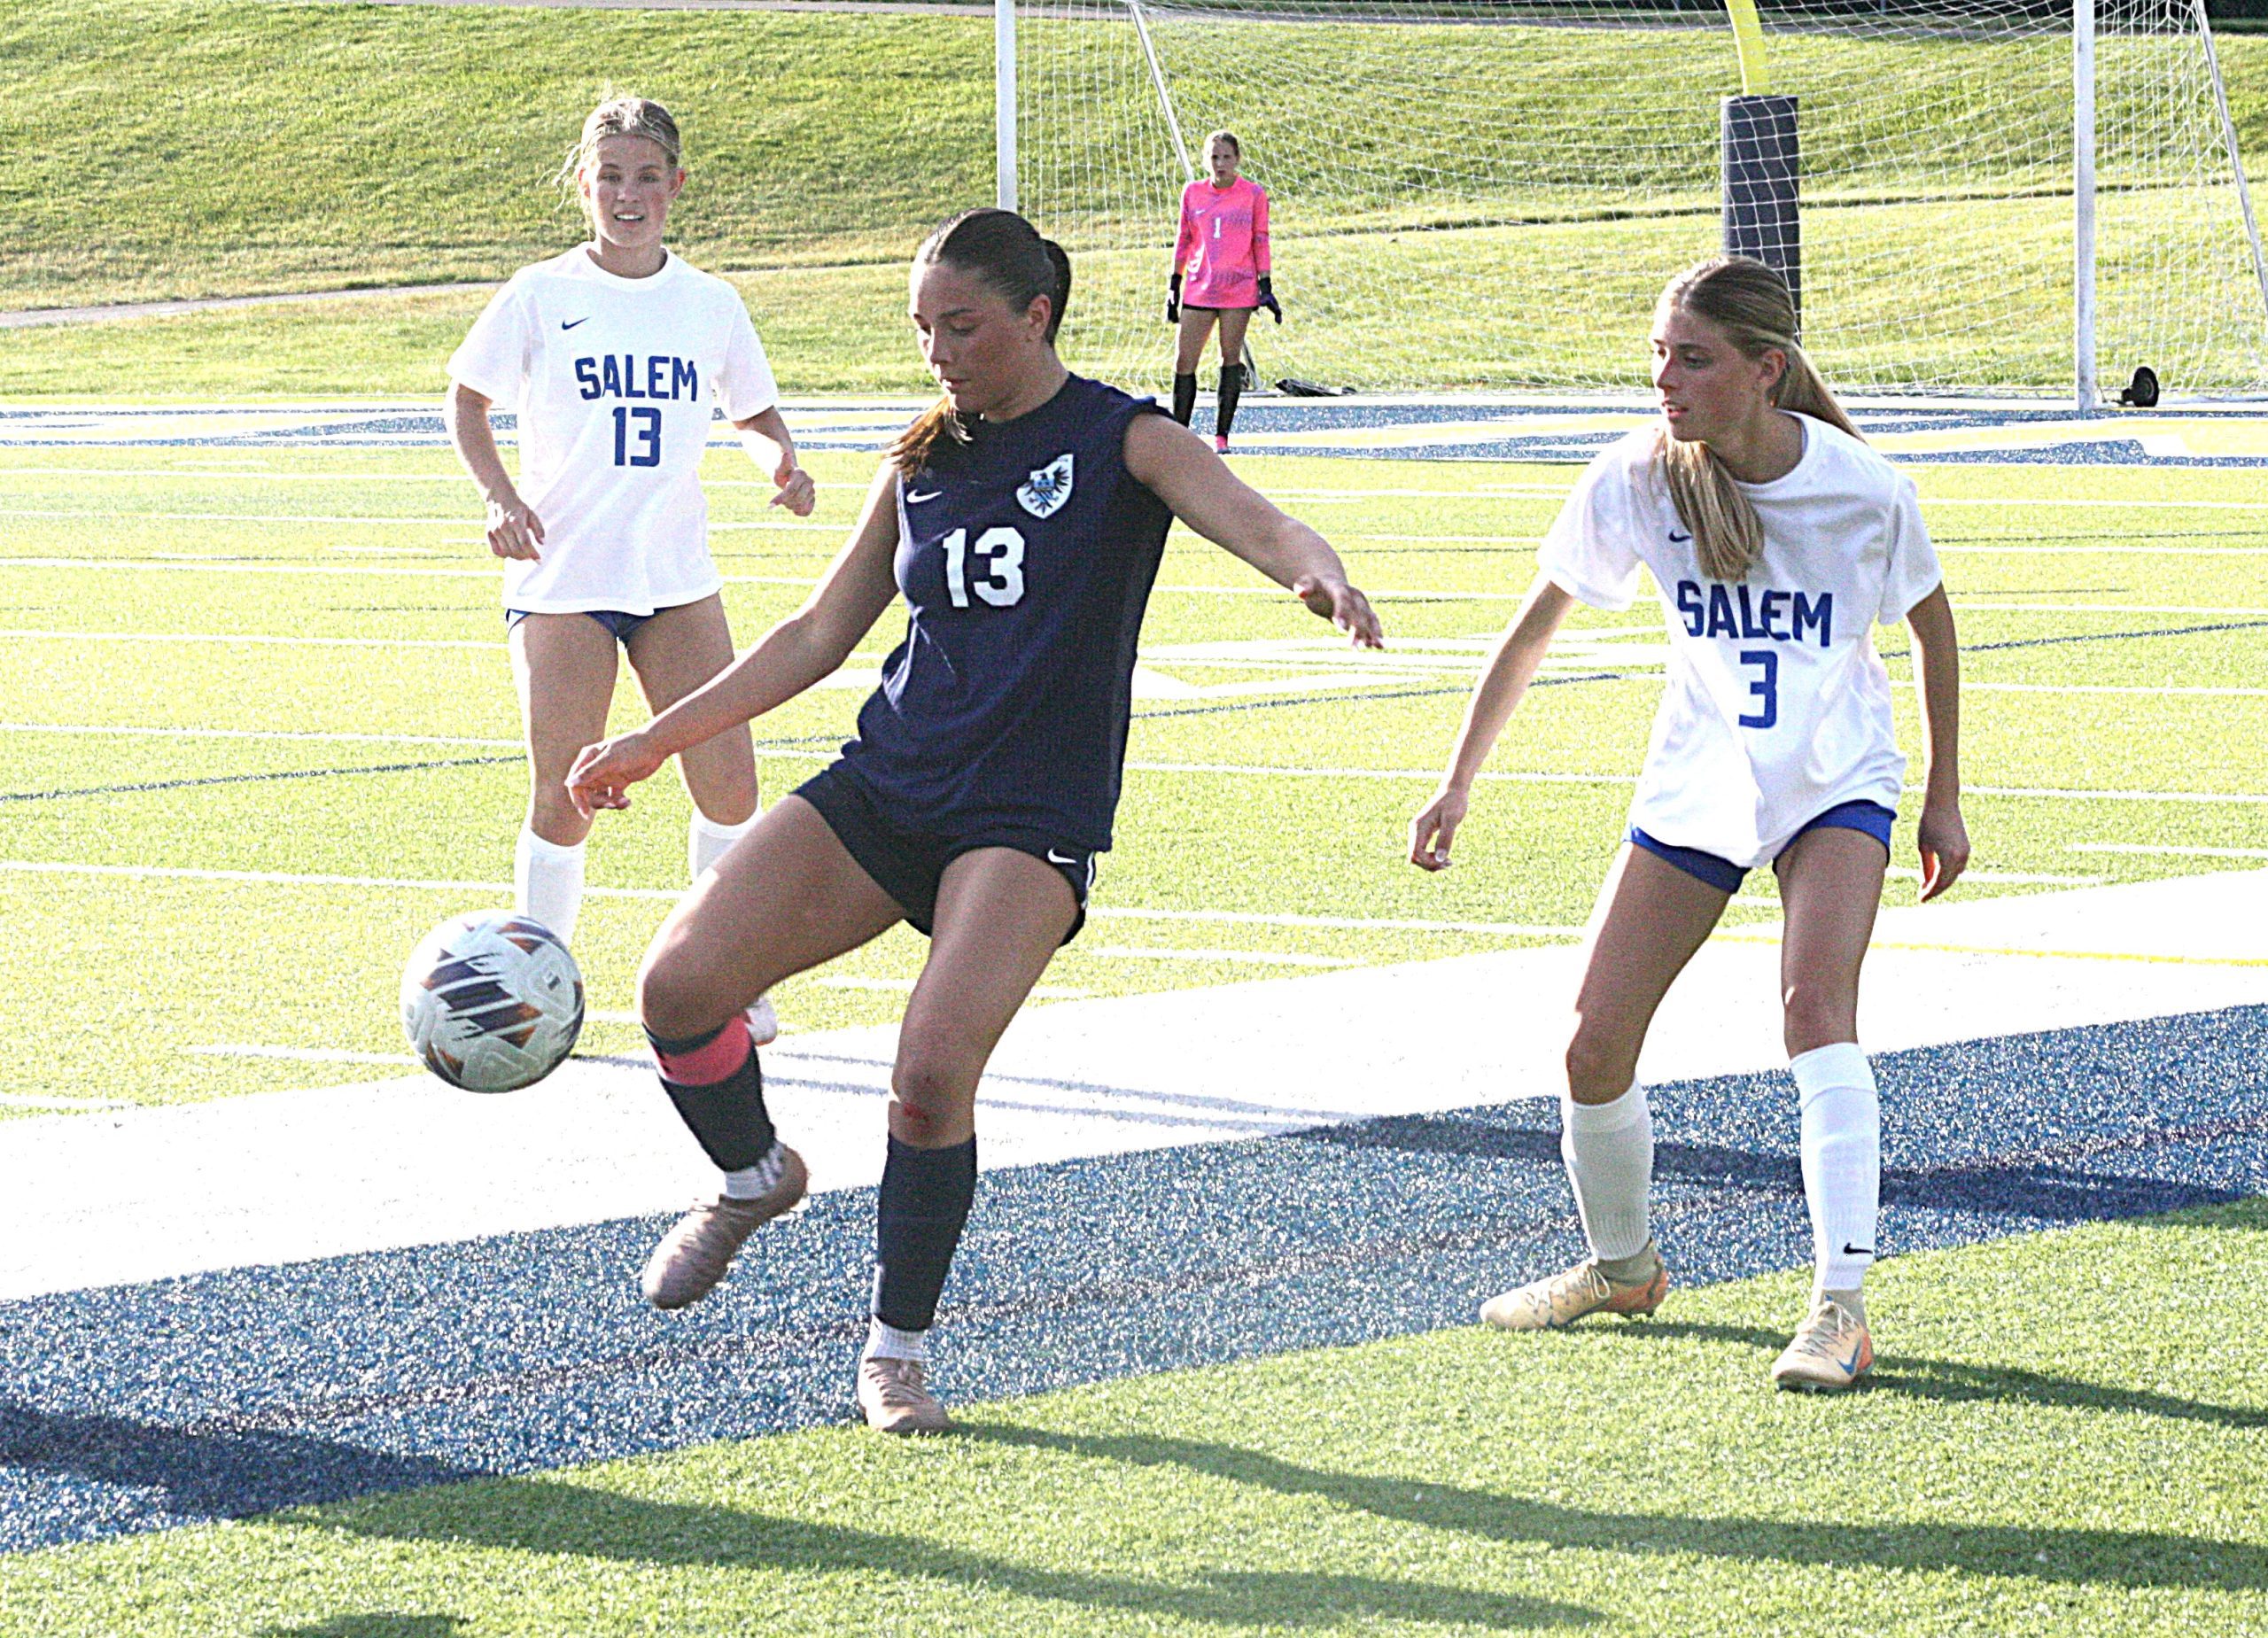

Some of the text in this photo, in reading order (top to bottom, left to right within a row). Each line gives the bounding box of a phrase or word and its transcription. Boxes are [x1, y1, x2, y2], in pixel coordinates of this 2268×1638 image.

[1213, 217, 1222, 239] 1
[574, 354, 698, 402] SALEM
[611, 407, 662, 468] 13
[943, 526, 1025, 608] 13
[1677, 580, 1833, 648] SALEM
[1738, 650, 1778, 729] 3
